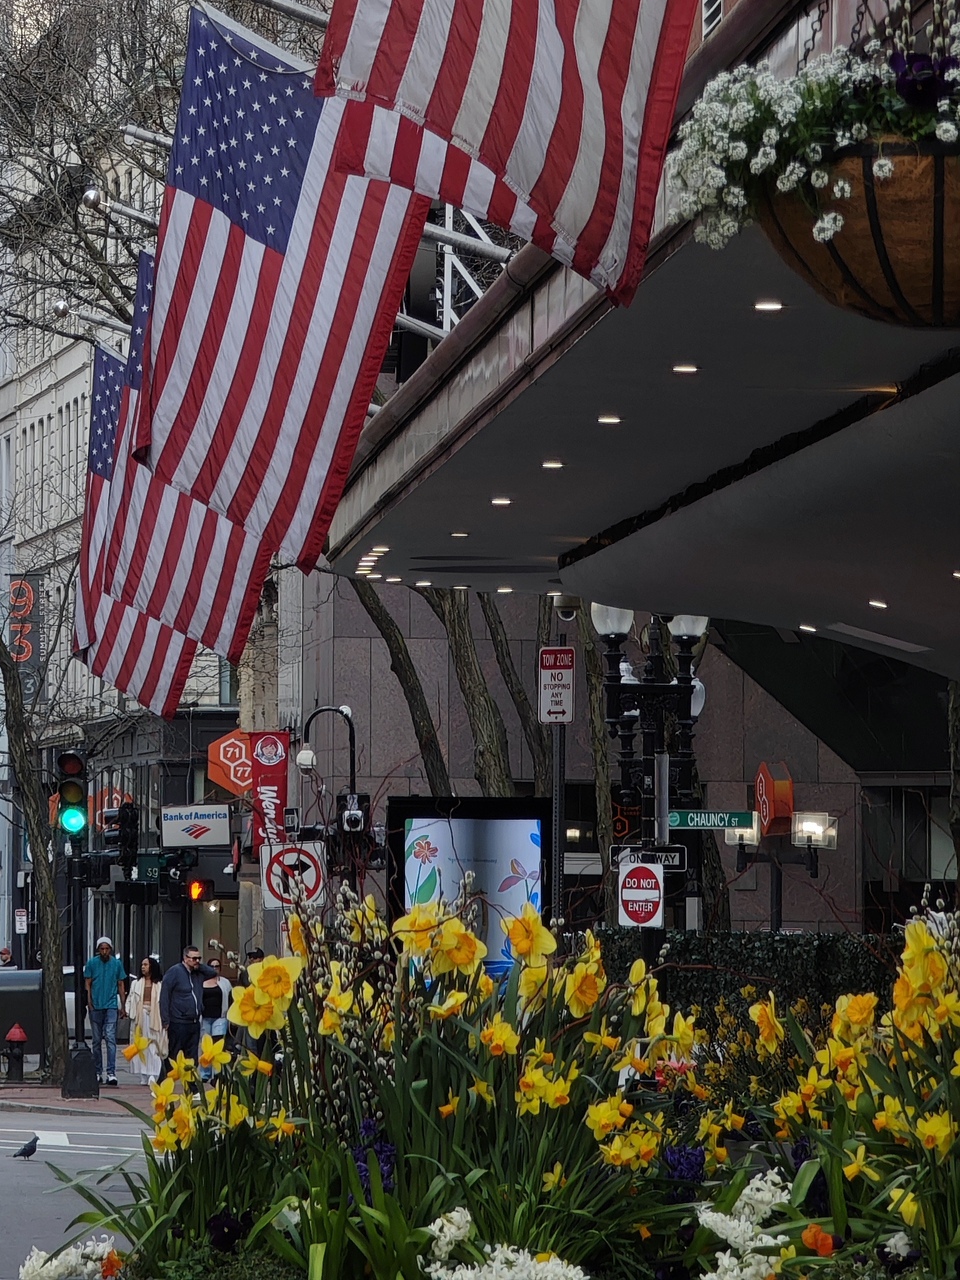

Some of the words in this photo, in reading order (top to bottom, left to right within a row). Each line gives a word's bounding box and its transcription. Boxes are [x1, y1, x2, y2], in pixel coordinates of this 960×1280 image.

[9, 580, 34, 662] 93
[542, 654, 555, 666] TOW
[556, 654, 572, 666] ZONE
[550, 672, 564, 682] NO
[543, 683, 571, 691] STOPPING
[225, 747, 240, 759] 71
[236, 766, 252, 778] 77
[163, 813, 184, 821] Bank
[184, 812, 192, 820] of
[193, 811, 227, 820] America
[687, 812, 730, 827] CHAUNCY
[731, 818, 738, 827] ST
[628, 852, 641, 864] ON
[656, 853, 677, 864] WAY
[626, 878, 638, 887] DO
[640, 878, 657, 887] NOT
[628, 902, 654, 912] ENTER
